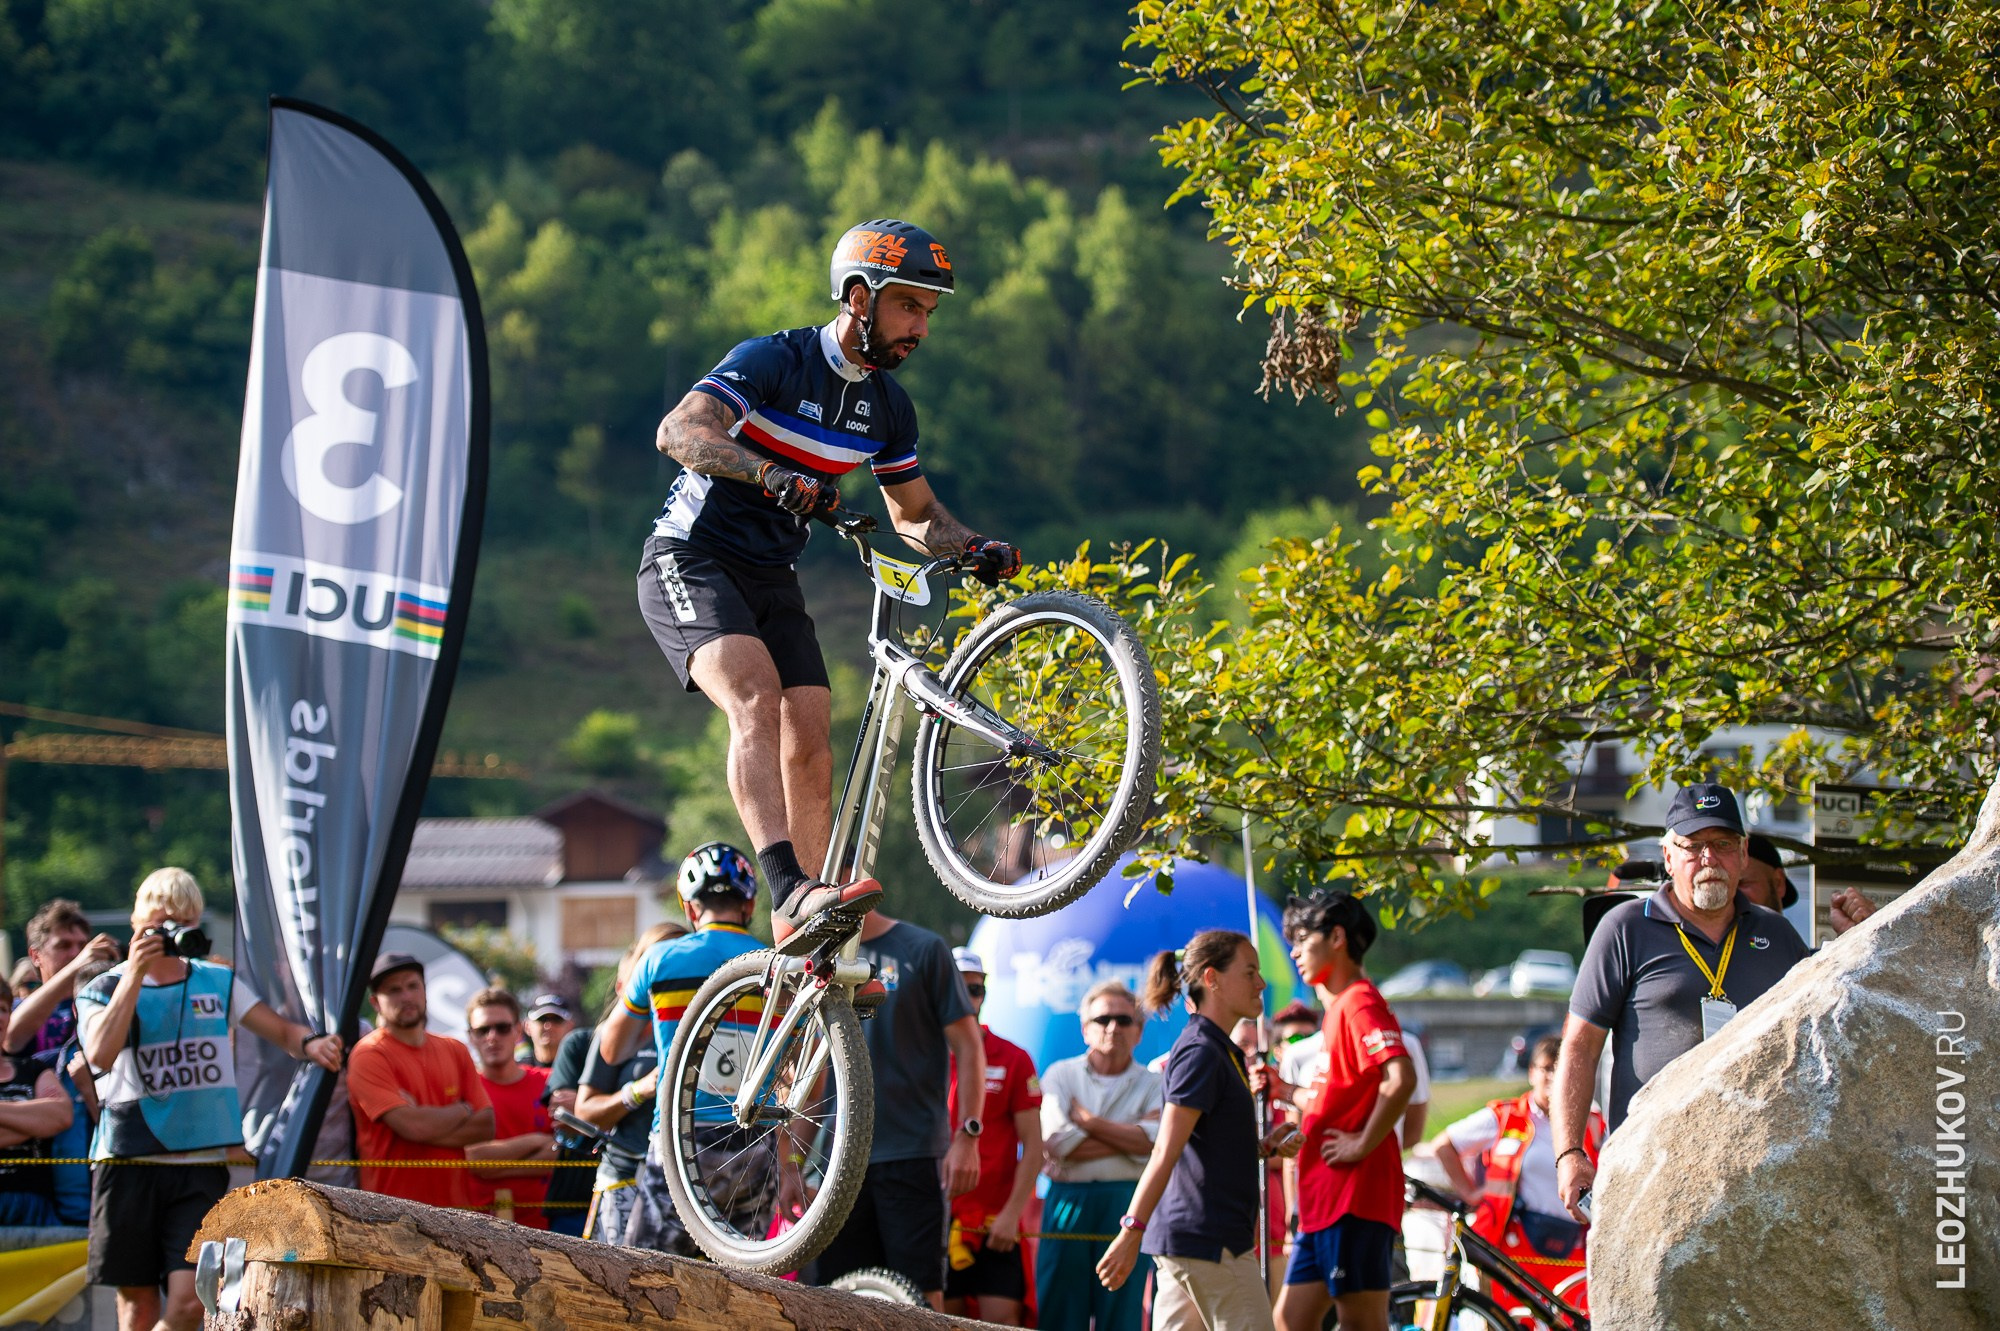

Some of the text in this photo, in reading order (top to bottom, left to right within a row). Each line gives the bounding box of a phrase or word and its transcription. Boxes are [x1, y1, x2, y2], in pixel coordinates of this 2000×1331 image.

[847, 230, 908, 254] TRIAL
[843, 245, 905, 267] IKES
[846, 419, 871, 434] LOOK
[892, 570, 905, 589] 5
[1821, 796, 1857, 813] UCI
[138, 1041, 218, 1068] VIDEO
[716, 1048, 735, 1077] 6
[141, 1064, 222, 1092] RADIO
